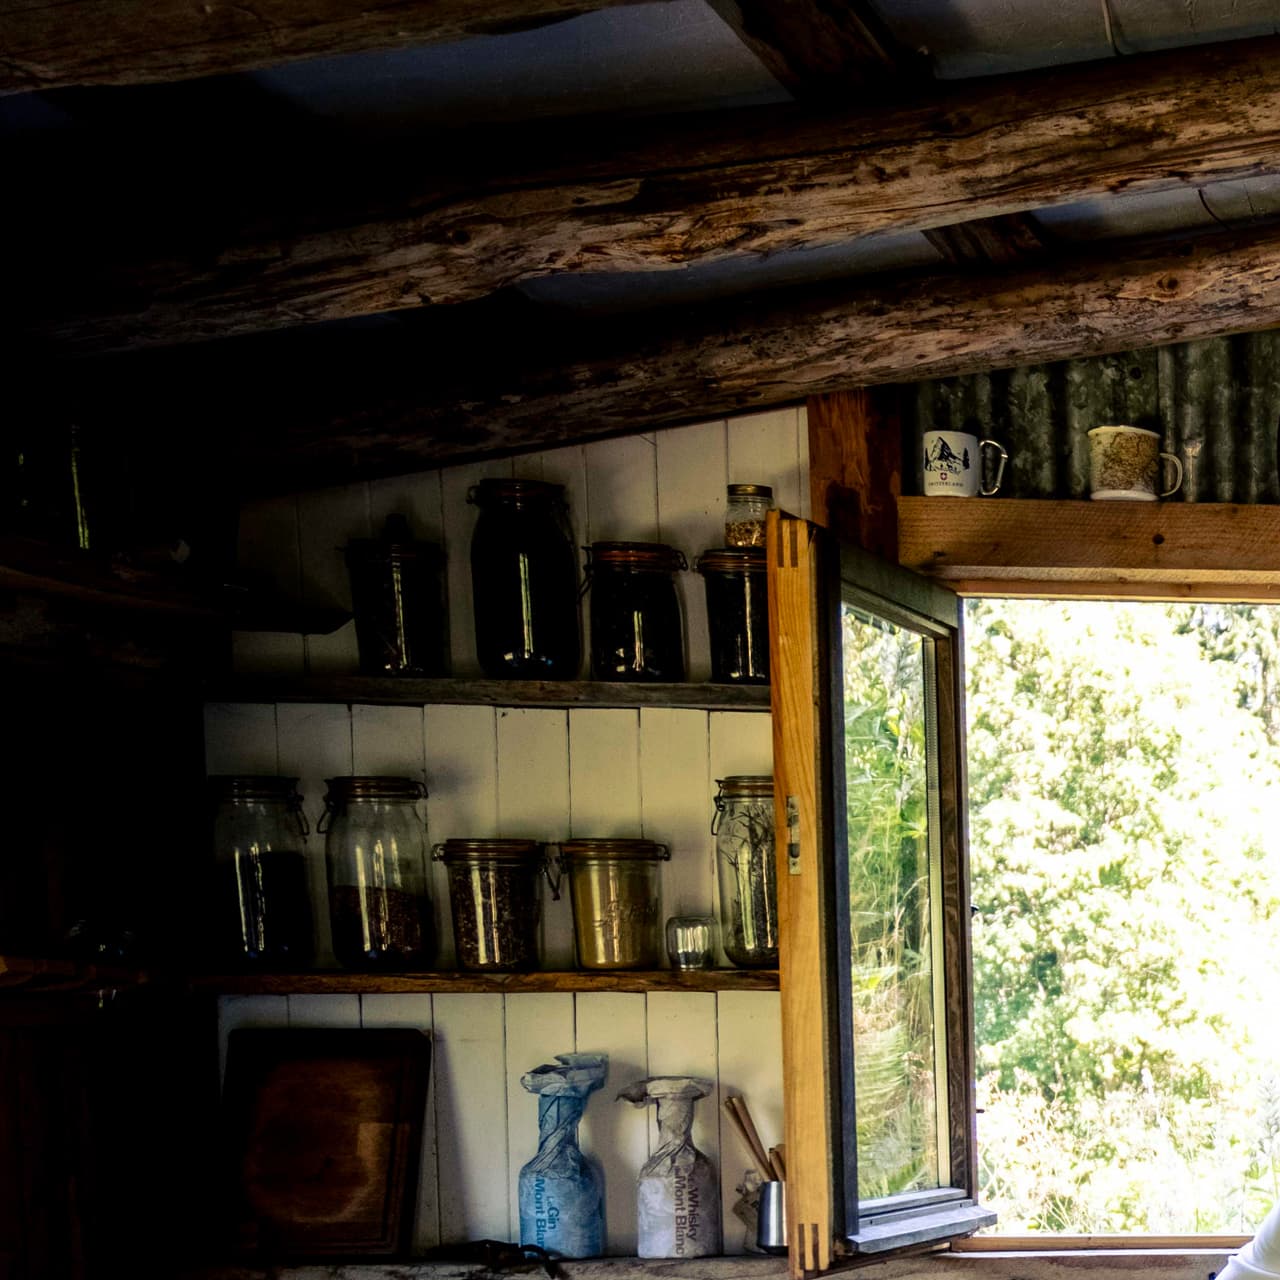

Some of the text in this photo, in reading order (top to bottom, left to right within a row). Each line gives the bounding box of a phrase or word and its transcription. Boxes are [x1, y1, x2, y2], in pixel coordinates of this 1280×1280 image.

[534, 1177, 547, 1248] Mont Blan
[547, 1206, 560, 1229] Gin
[674, 1176, 688, 1255] Mont Blanc
[686, 1186, 700, 1241] Whisky
